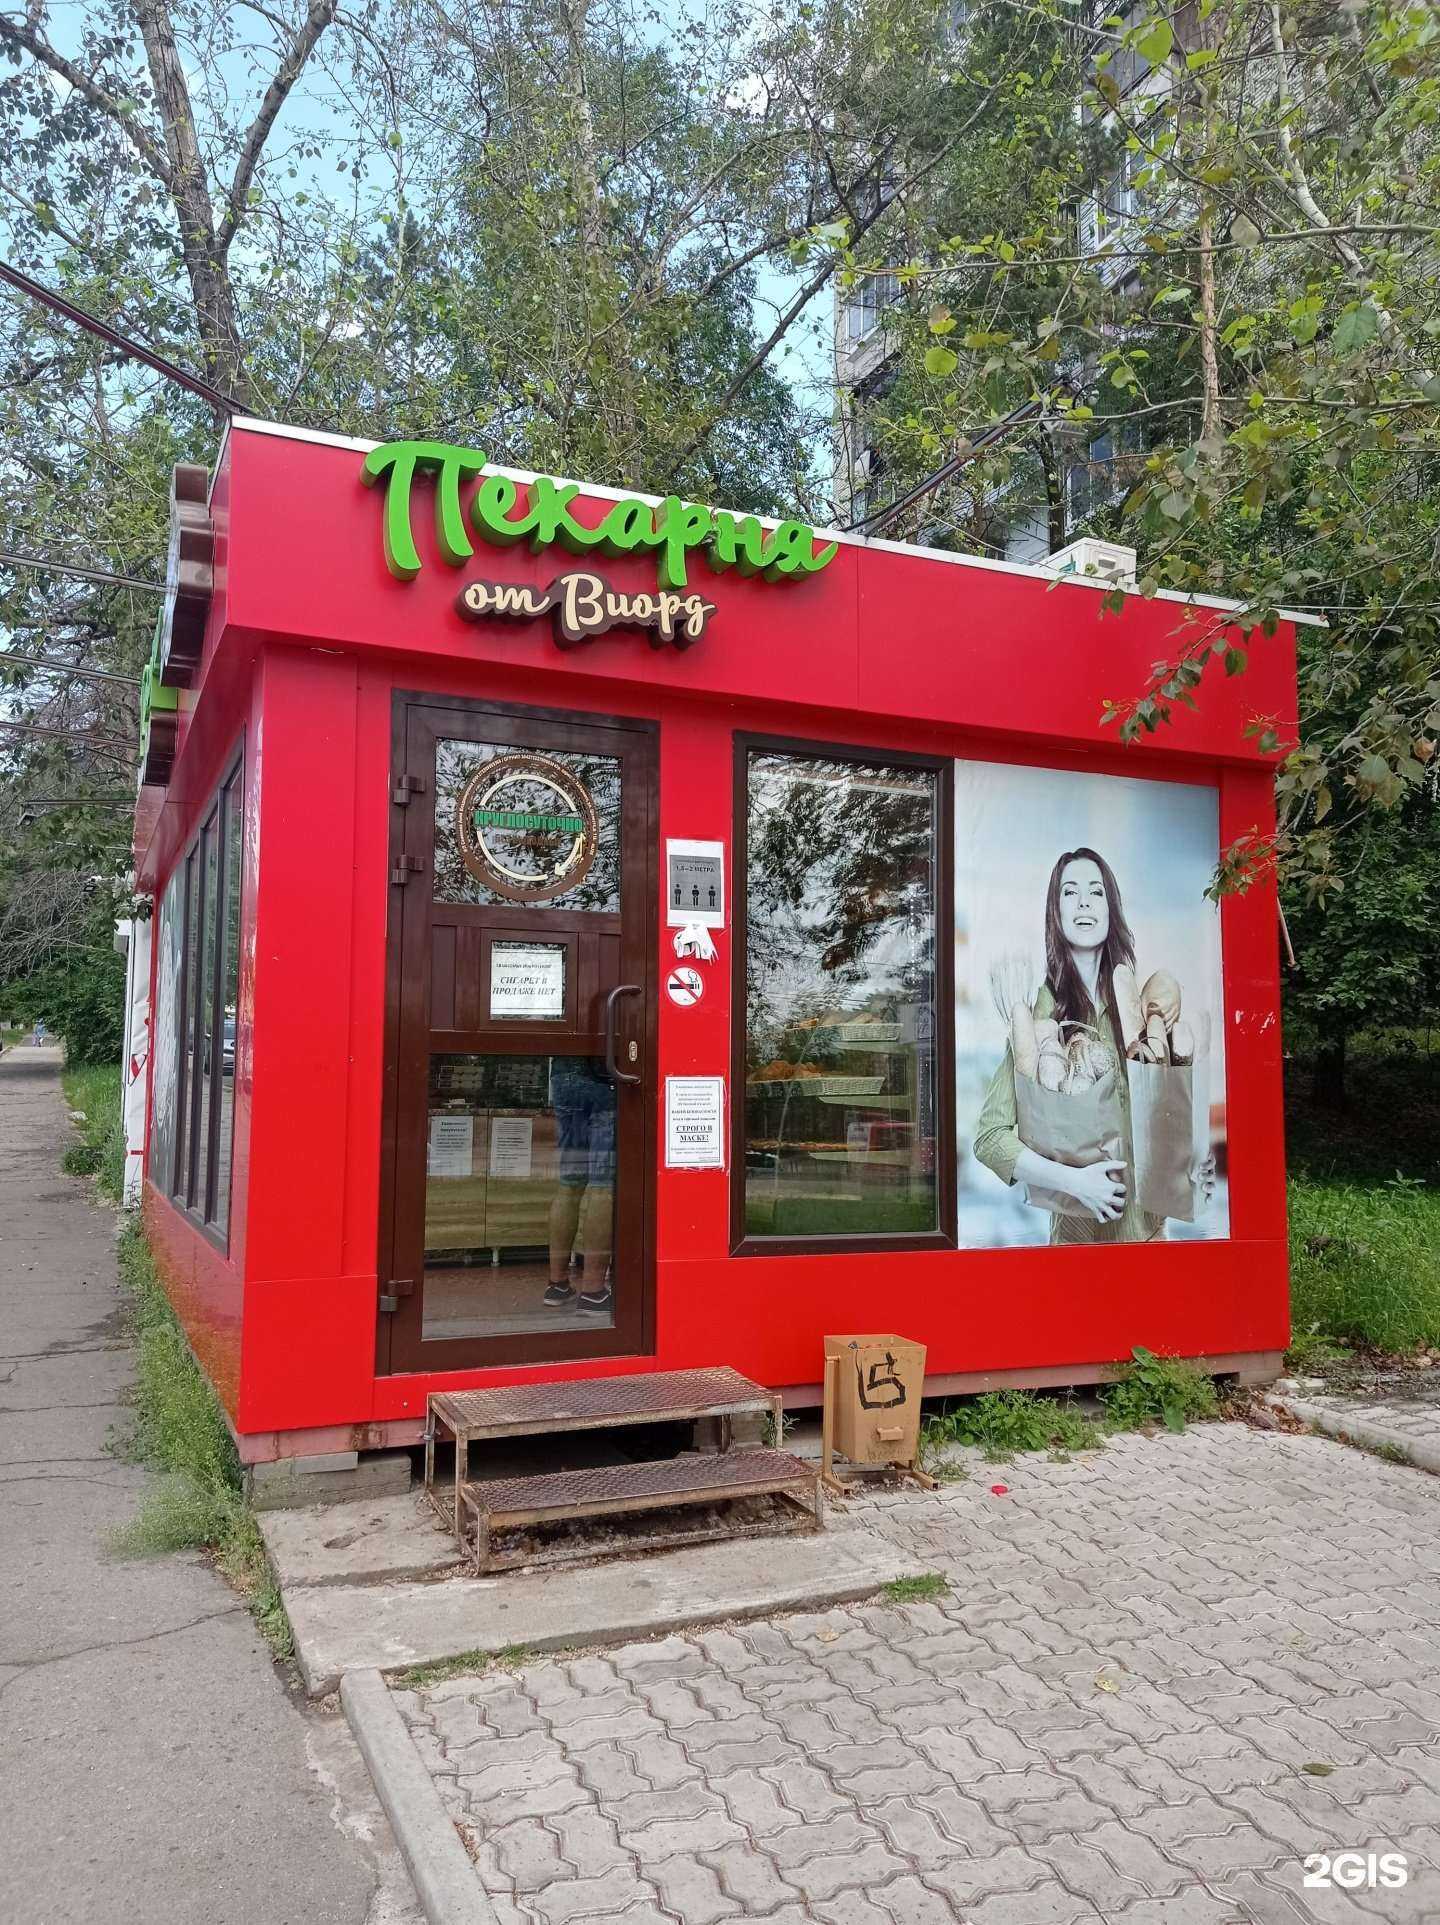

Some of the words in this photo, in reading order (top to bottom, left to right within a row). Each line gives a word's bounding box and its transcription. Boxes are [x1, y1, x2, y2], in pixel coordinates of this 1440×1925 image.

[360, 442, 838, 588] Пекарня
[464, 582, 550, 613] от
[561, 573, 715, 635] Виорд
[474, 810, 583, 832] КРУГЛОСУТОЧНО
